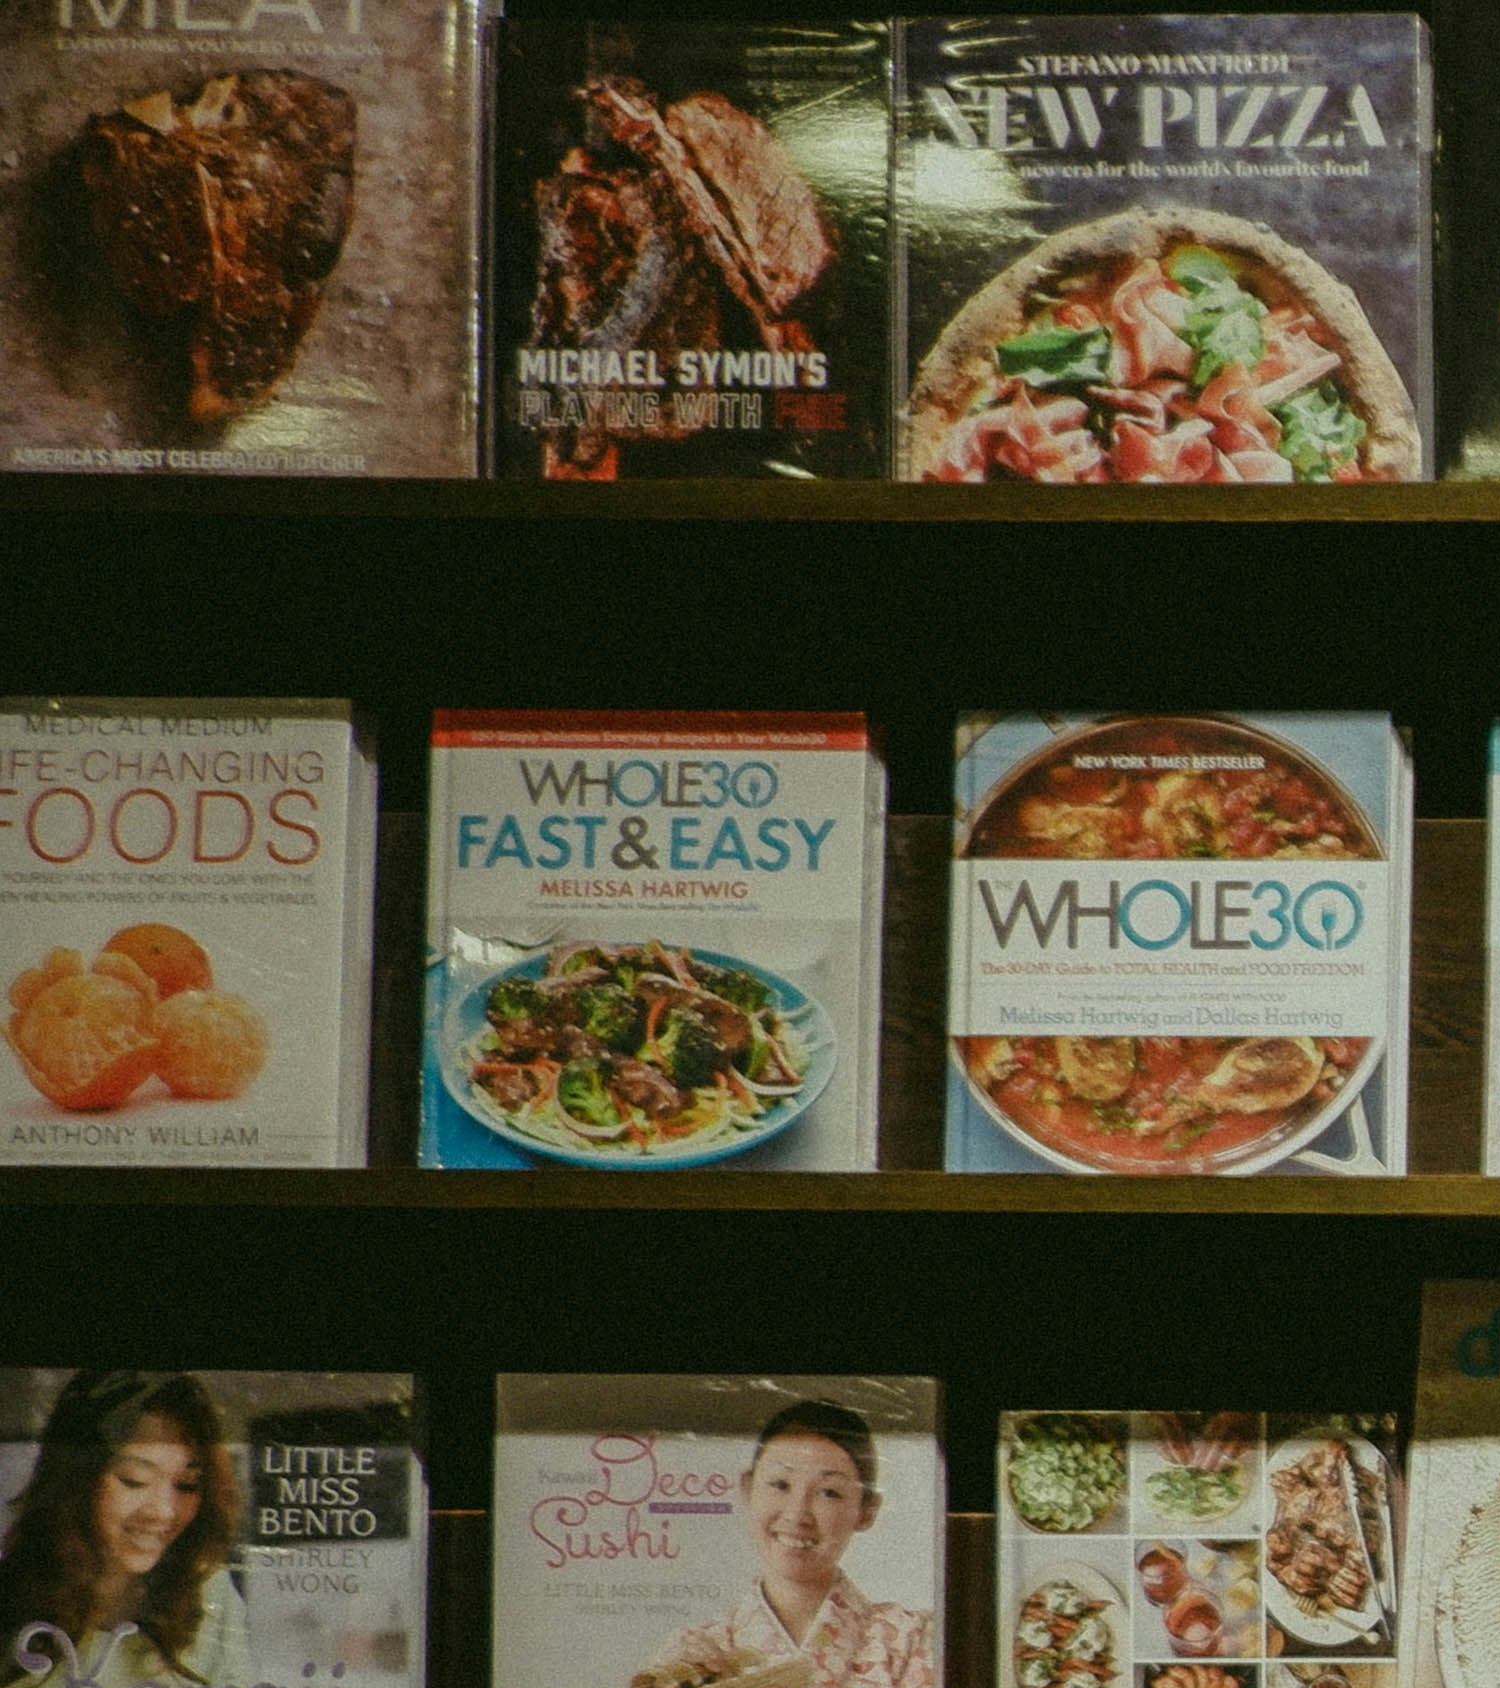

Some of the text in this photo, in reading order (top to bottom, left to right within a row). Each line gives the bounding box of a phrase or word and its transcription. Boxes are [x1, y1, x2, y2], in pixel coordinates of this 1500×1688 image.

[924, 85, 1388, 149] NEW PIZZA
[518, 351, 828, 387] MICHAEL SYMON'S
[1075, 755, 1266, 770] NEW YORK TIMES BESTSELLER
[518, 760, 779, 808] WHOLE30
[458, 815, 837, 873] FAST & EASY
[263, 1446, 376, 1475] LITTLE
[279, 1478, 360, 1504] MISS
[260, 1506, 376, 1538] BENTO
